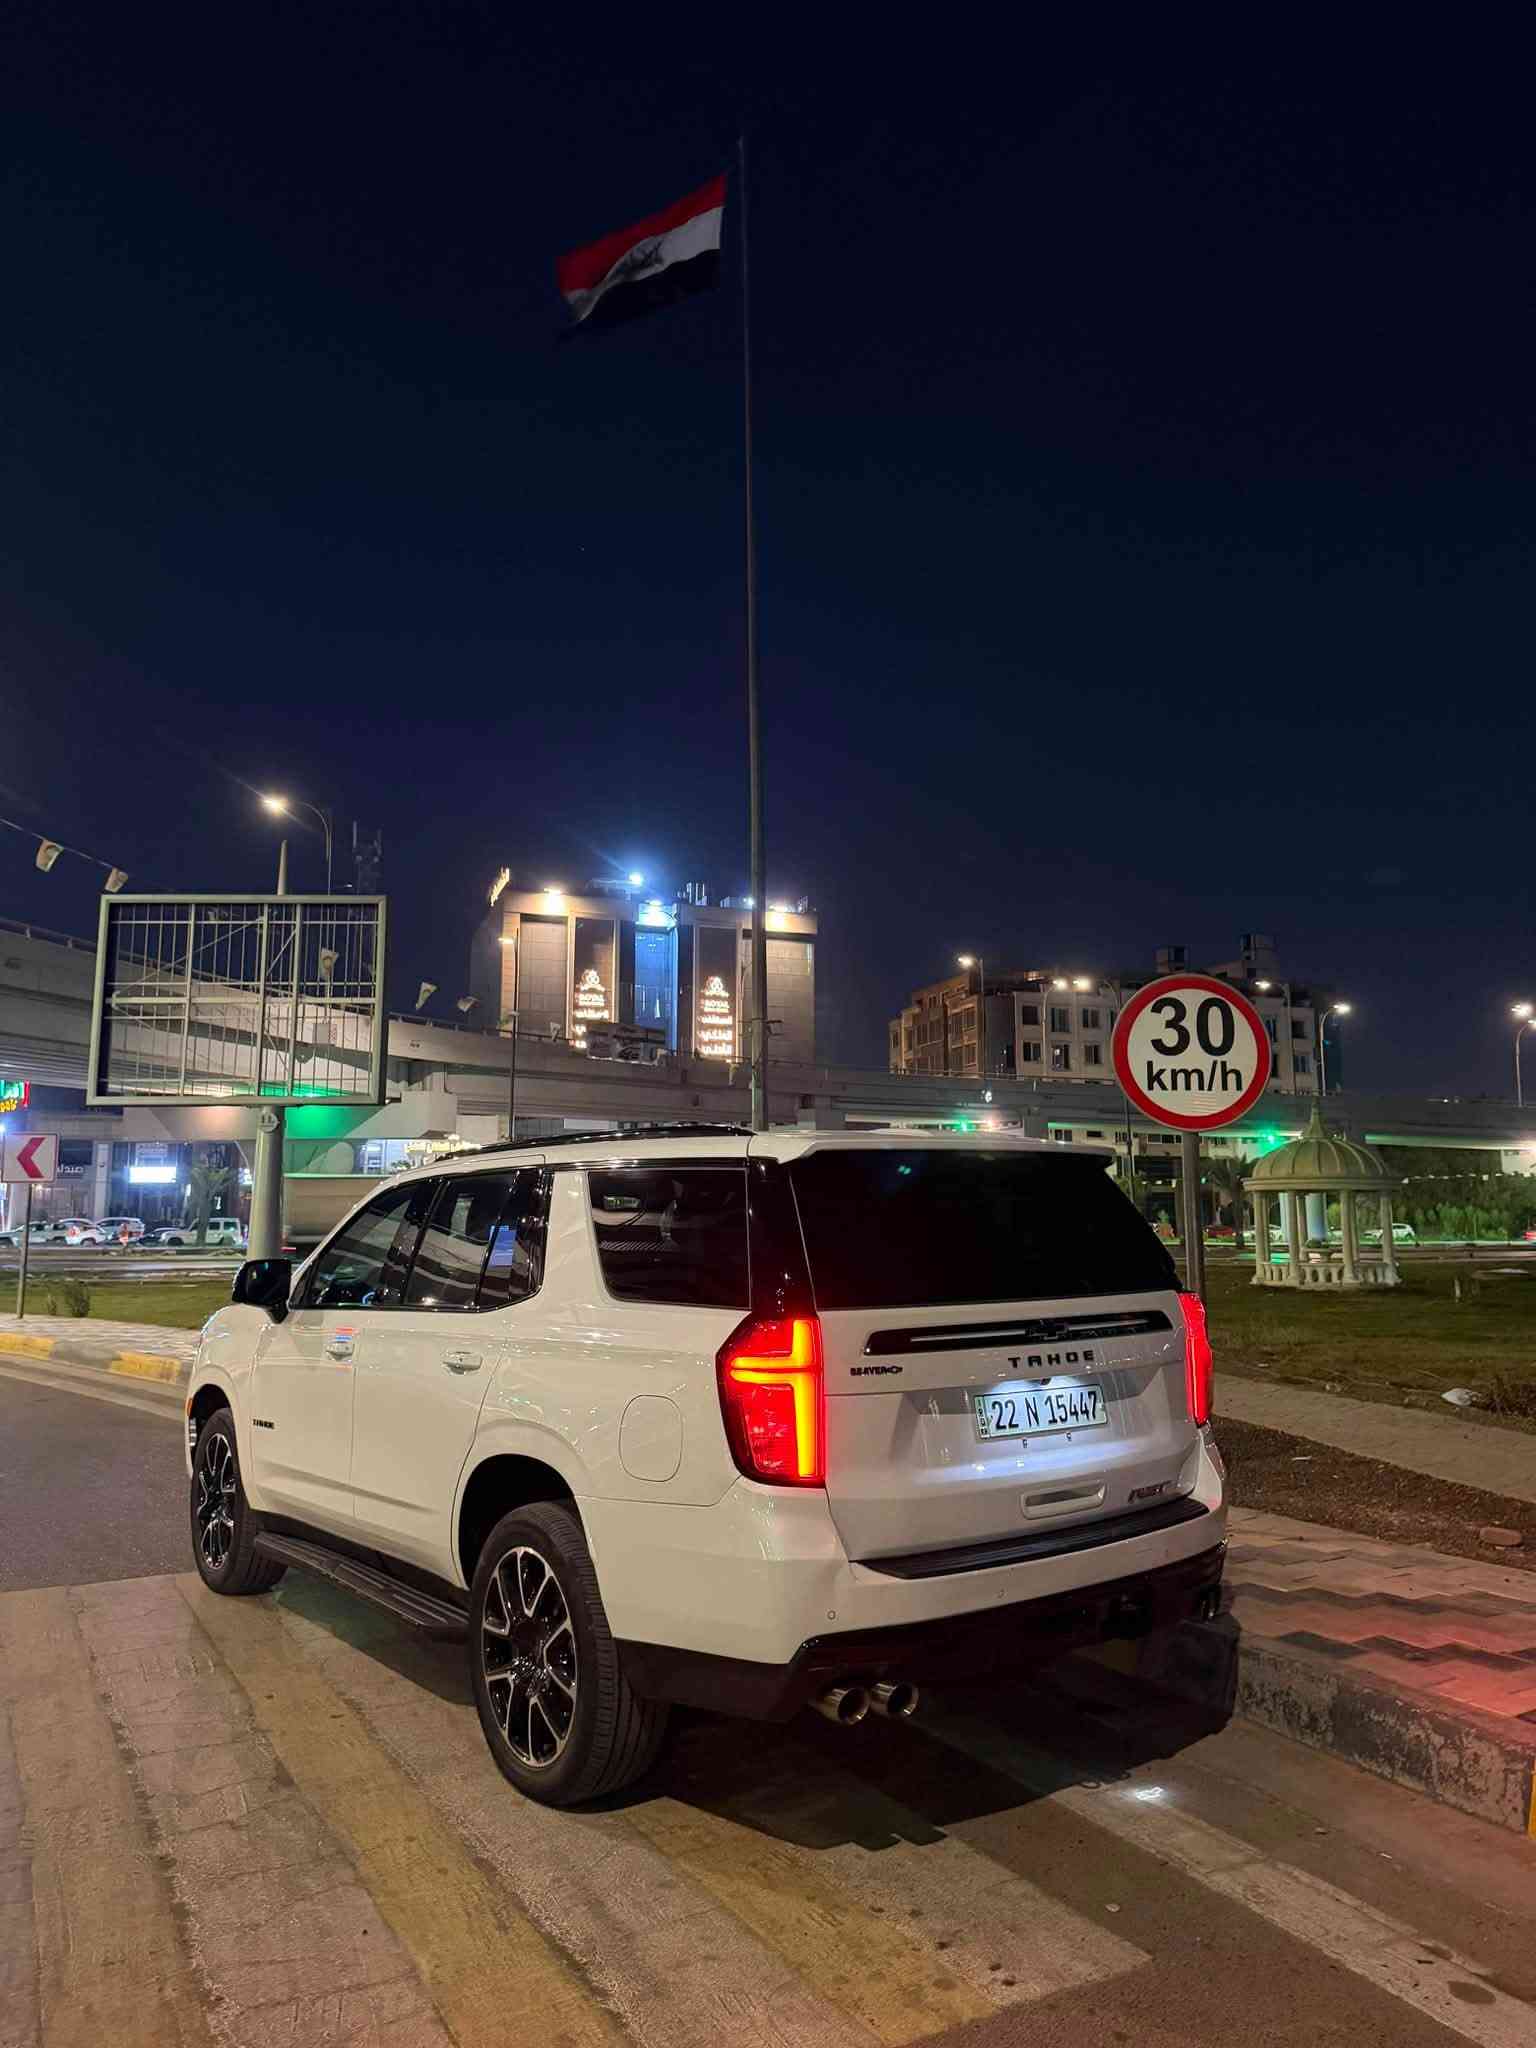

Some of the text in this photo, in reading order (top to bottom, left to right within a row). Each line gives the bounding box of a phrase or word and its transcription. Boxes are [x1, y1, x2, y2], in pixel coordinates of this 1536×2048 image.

[1150, 997, 1235, 1056] 30
[1146, 1060, 1243, 1091] km/h
[1008, 1350, 1094, 1368] TAHOE
[991, 1391, 1097, 1430] 22 N 15447
